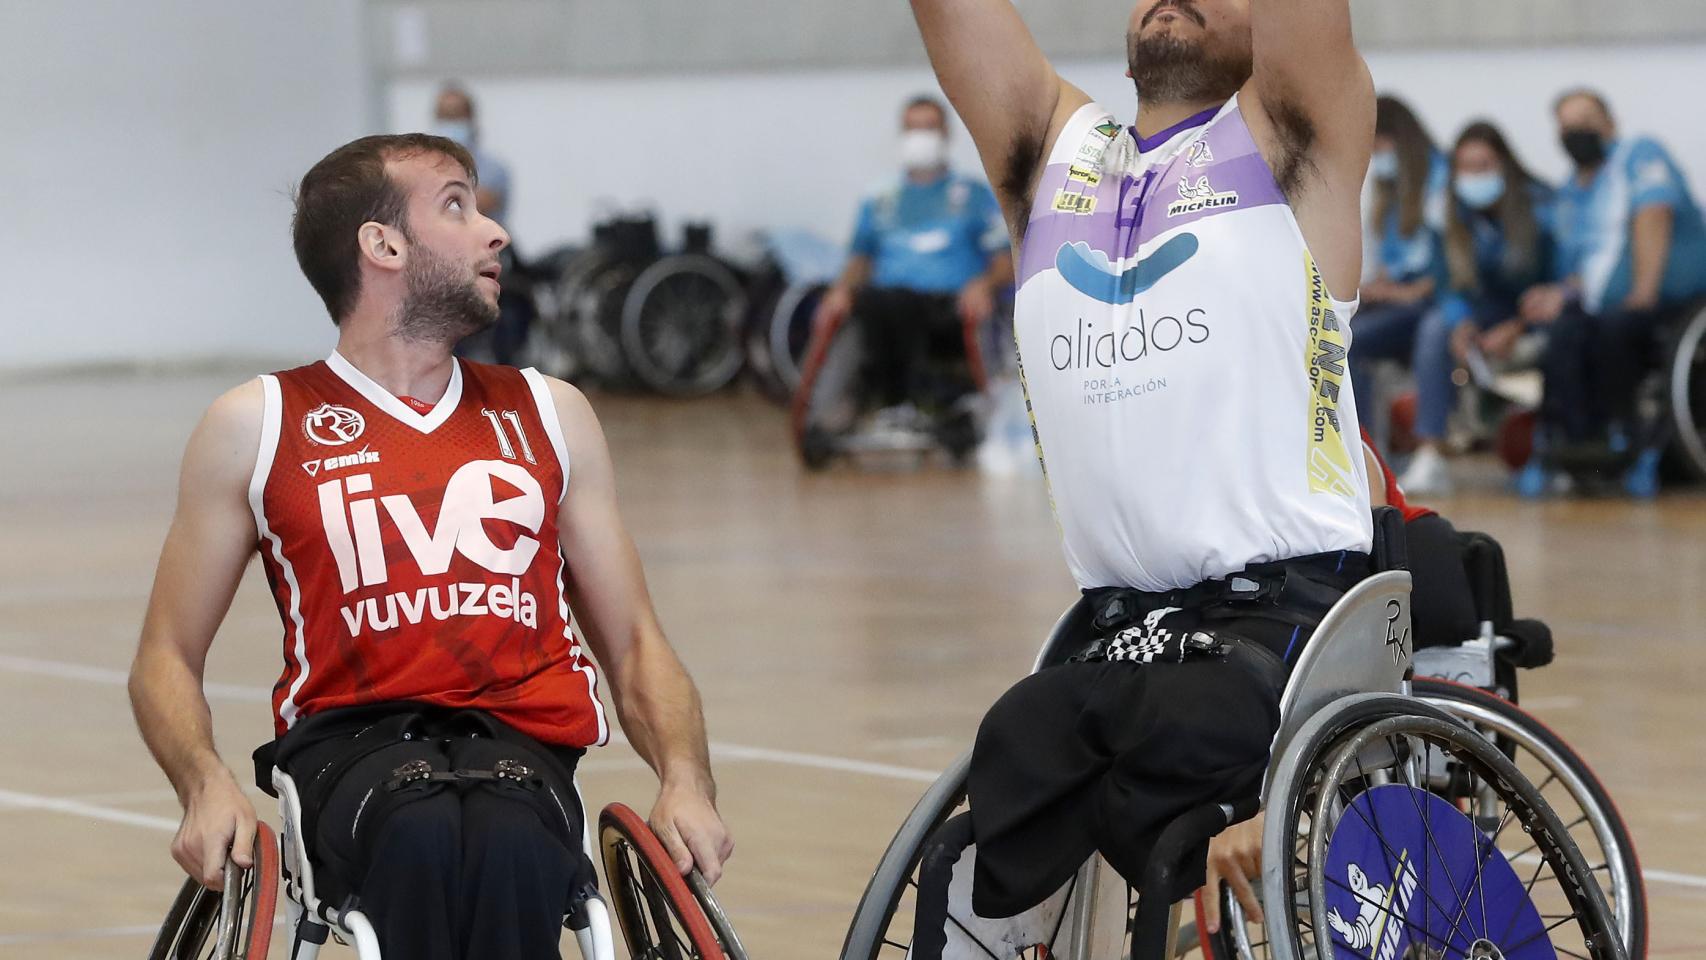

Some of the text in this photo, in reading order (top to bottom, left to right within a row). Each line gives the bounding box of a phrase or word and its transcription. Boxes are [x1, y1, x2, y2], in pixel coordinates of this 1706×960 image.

[1050, 308, 1210, 371] aliados
[1083, 377, 1121, 390] POR A
[323, 443, 380, 471] emix
[481, 407, 537, 466] 11
[317, 459, 546, 595] live
[340, 577, 538, 637] vuvuzela
